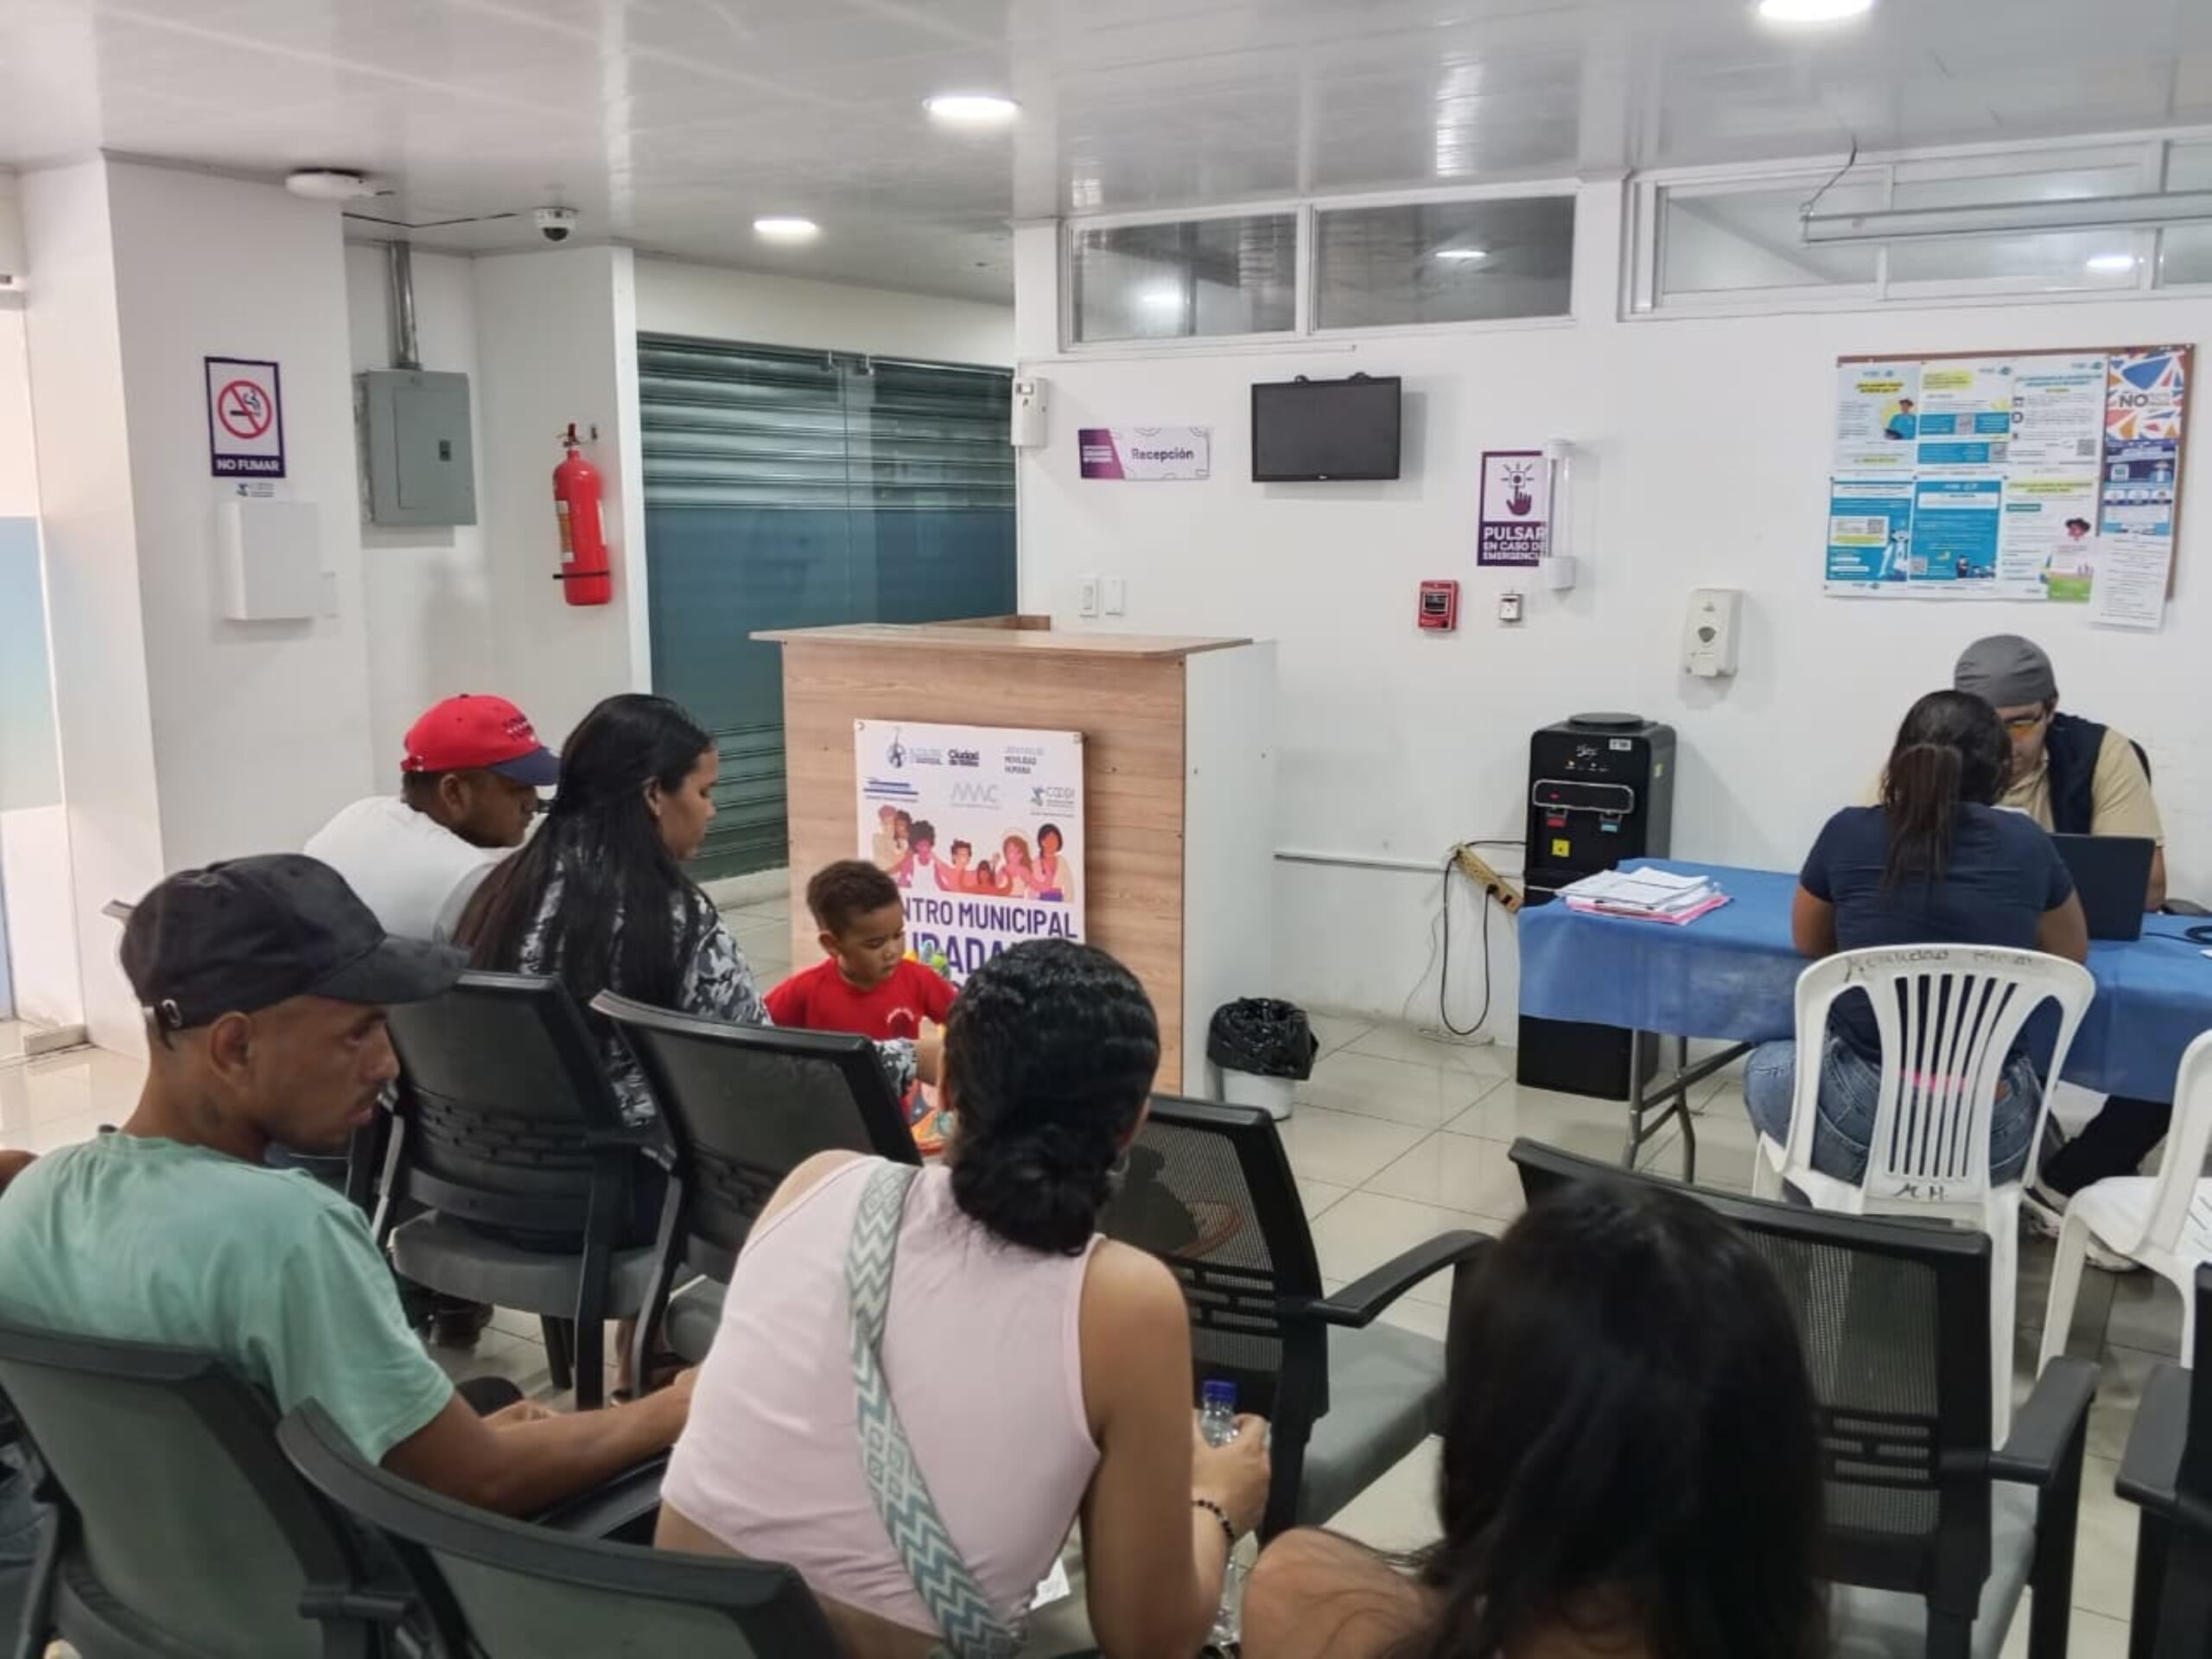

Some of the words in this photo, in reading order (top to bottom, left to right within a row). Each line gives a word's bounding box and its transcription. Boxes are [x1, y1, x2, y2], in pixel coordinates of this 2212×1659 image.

[1132, 447, 1195, 463] Recepción
[216, 459, 236, 471] NO
[238, 459, 278, 471] FUMAR
[1499, 541, 1529, 551] CASO
[959, 902, 1078, 938] MUNICIPAL
